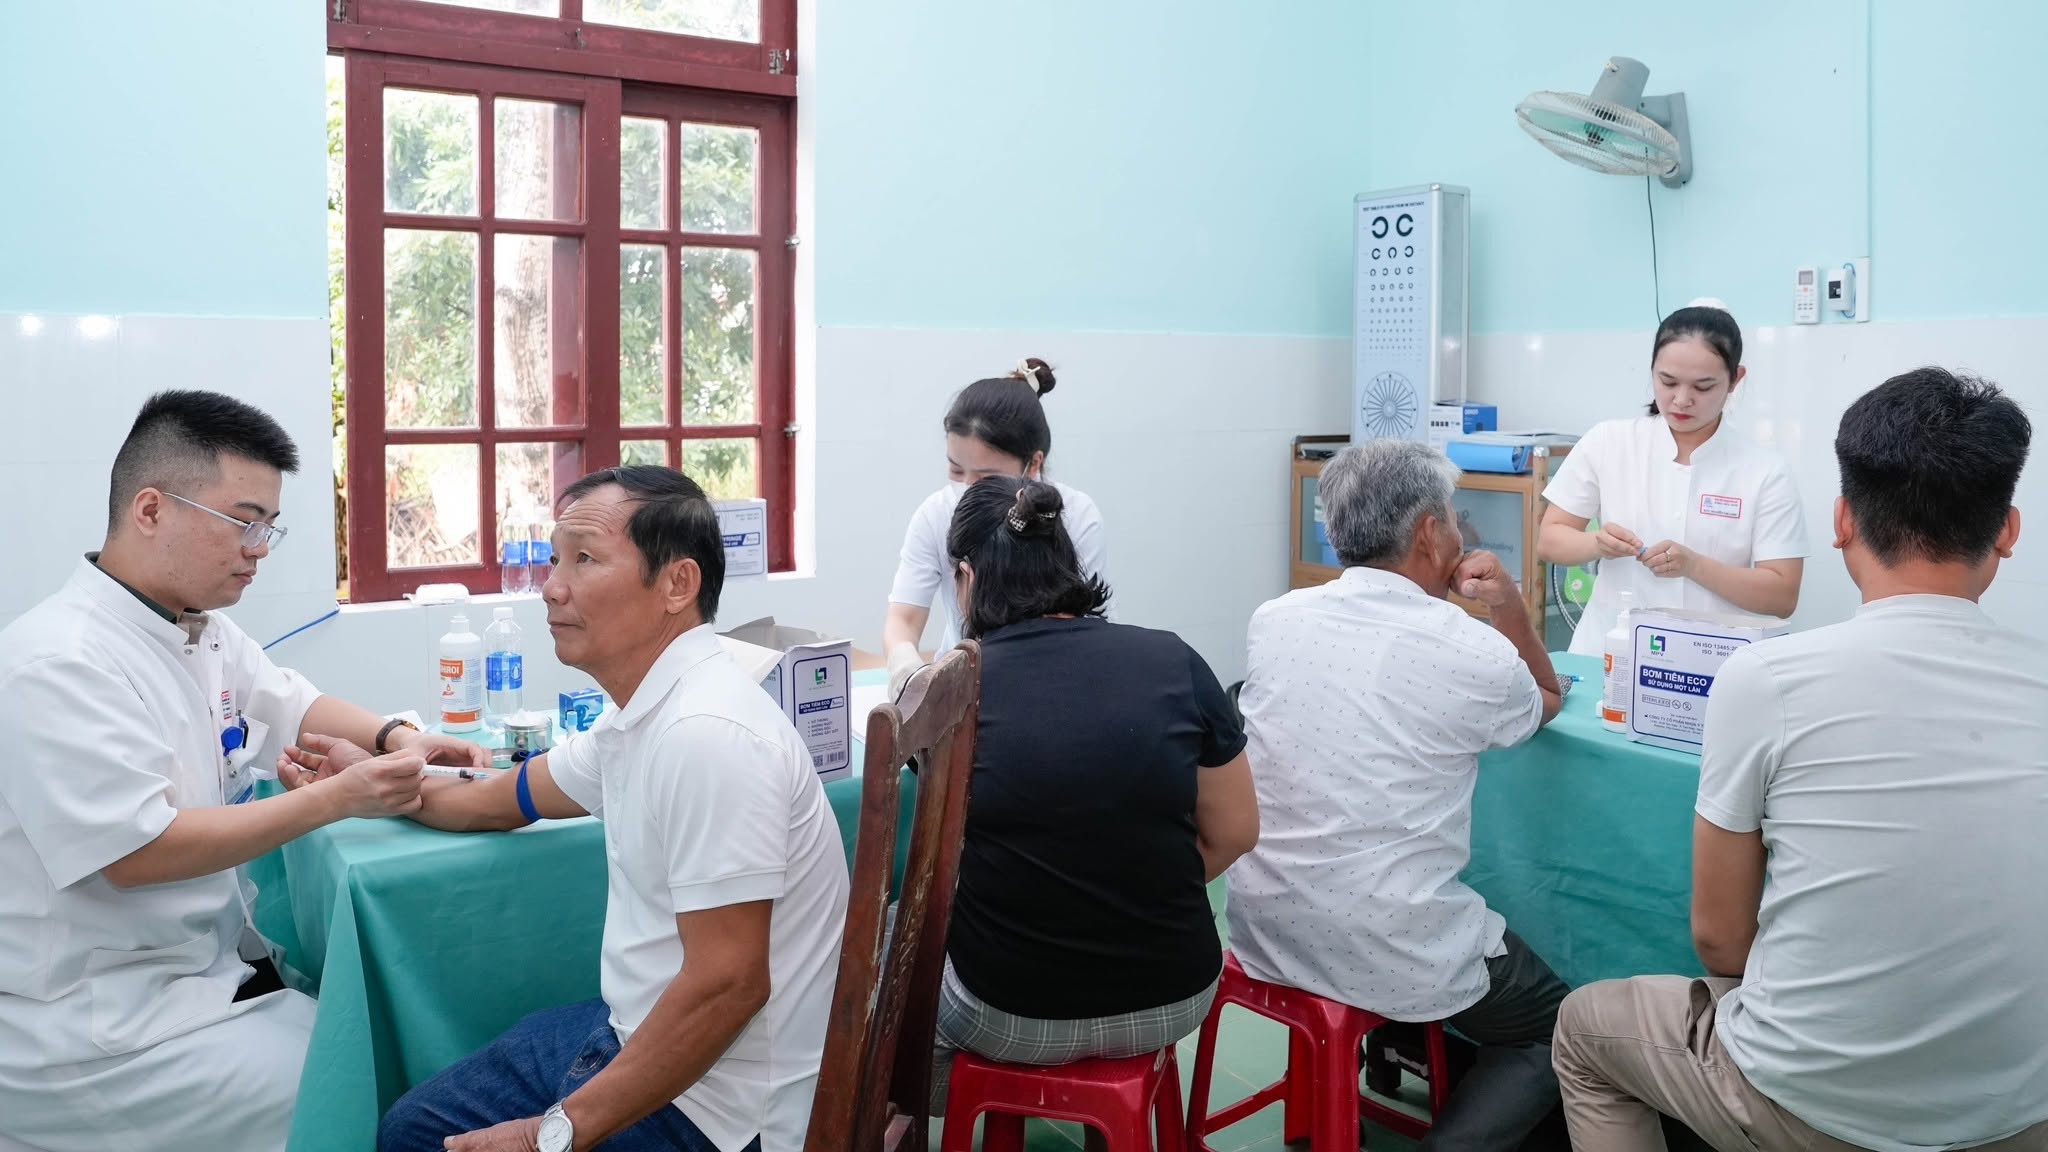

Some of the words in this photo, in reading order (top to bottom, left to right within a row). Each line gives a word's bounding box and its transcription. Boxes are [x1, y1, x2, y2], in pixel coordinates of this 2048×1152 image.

[1642, 668, 1662, 679] BƠM
[1664, 672, 1685, 683] TIÊM
[1687, 676, 1707, 687] ECO
